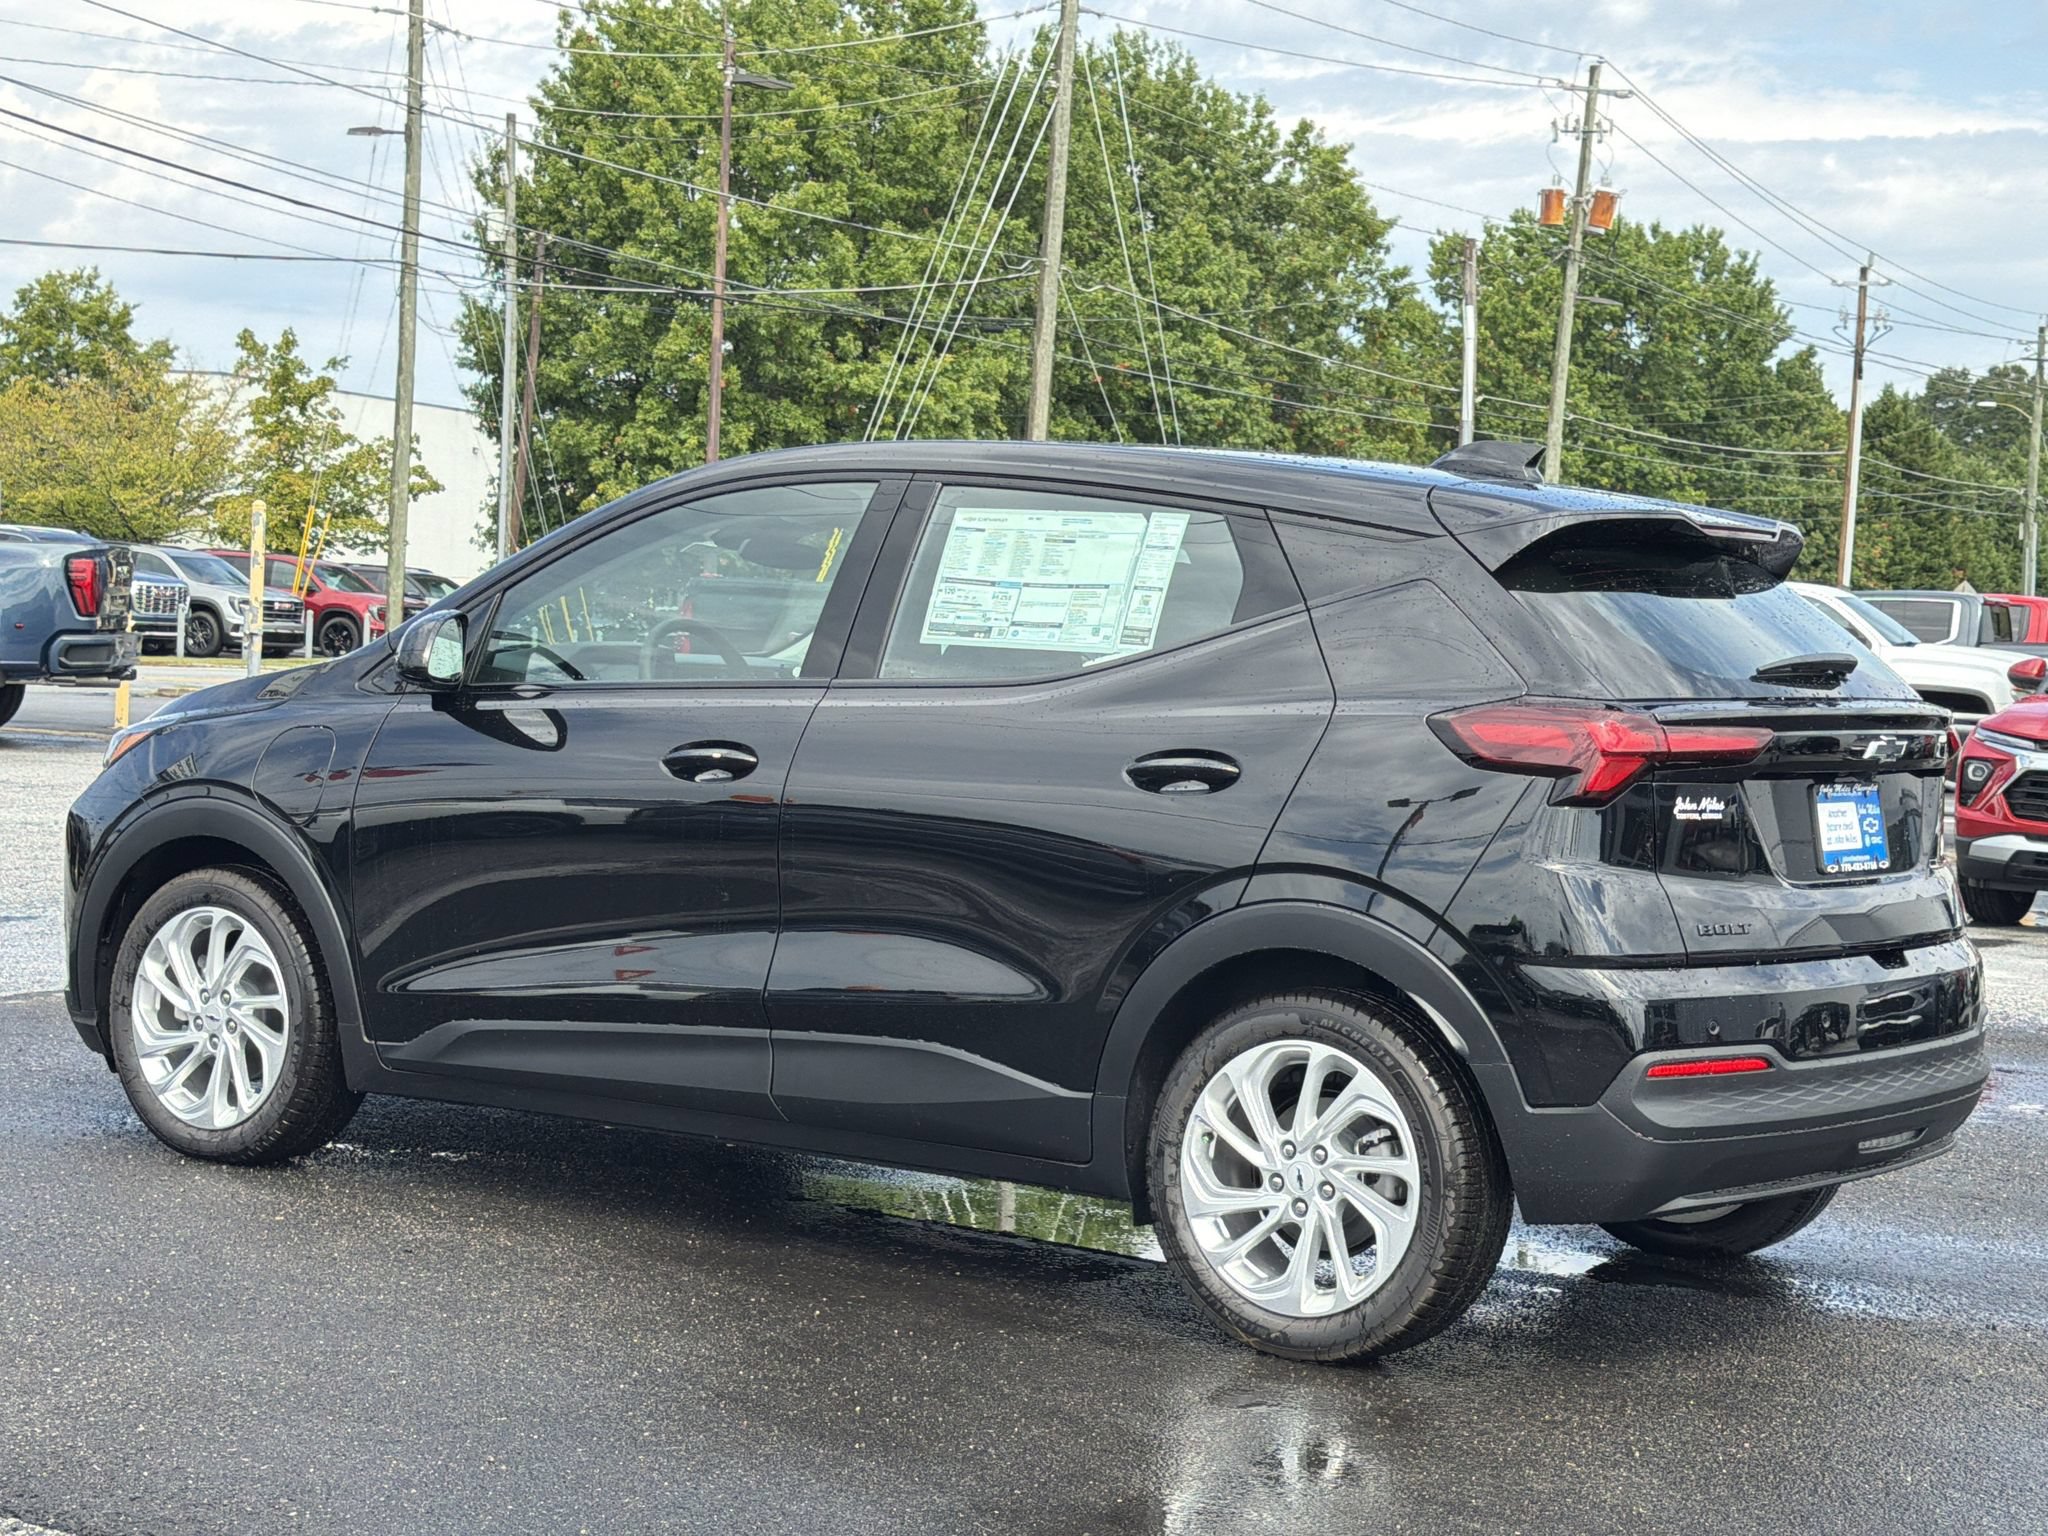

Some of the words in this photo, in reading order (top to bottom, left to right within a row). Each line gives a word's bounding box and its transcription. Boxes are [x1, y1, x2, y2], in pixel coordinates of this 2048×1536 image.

[1673, 796, 1698, 815] John
[1698, 796, 1726, 812] Miles
[1696, 923, 1752, 937] BOLT
[1320, 1018, 1395, 1068] MICHELIN
